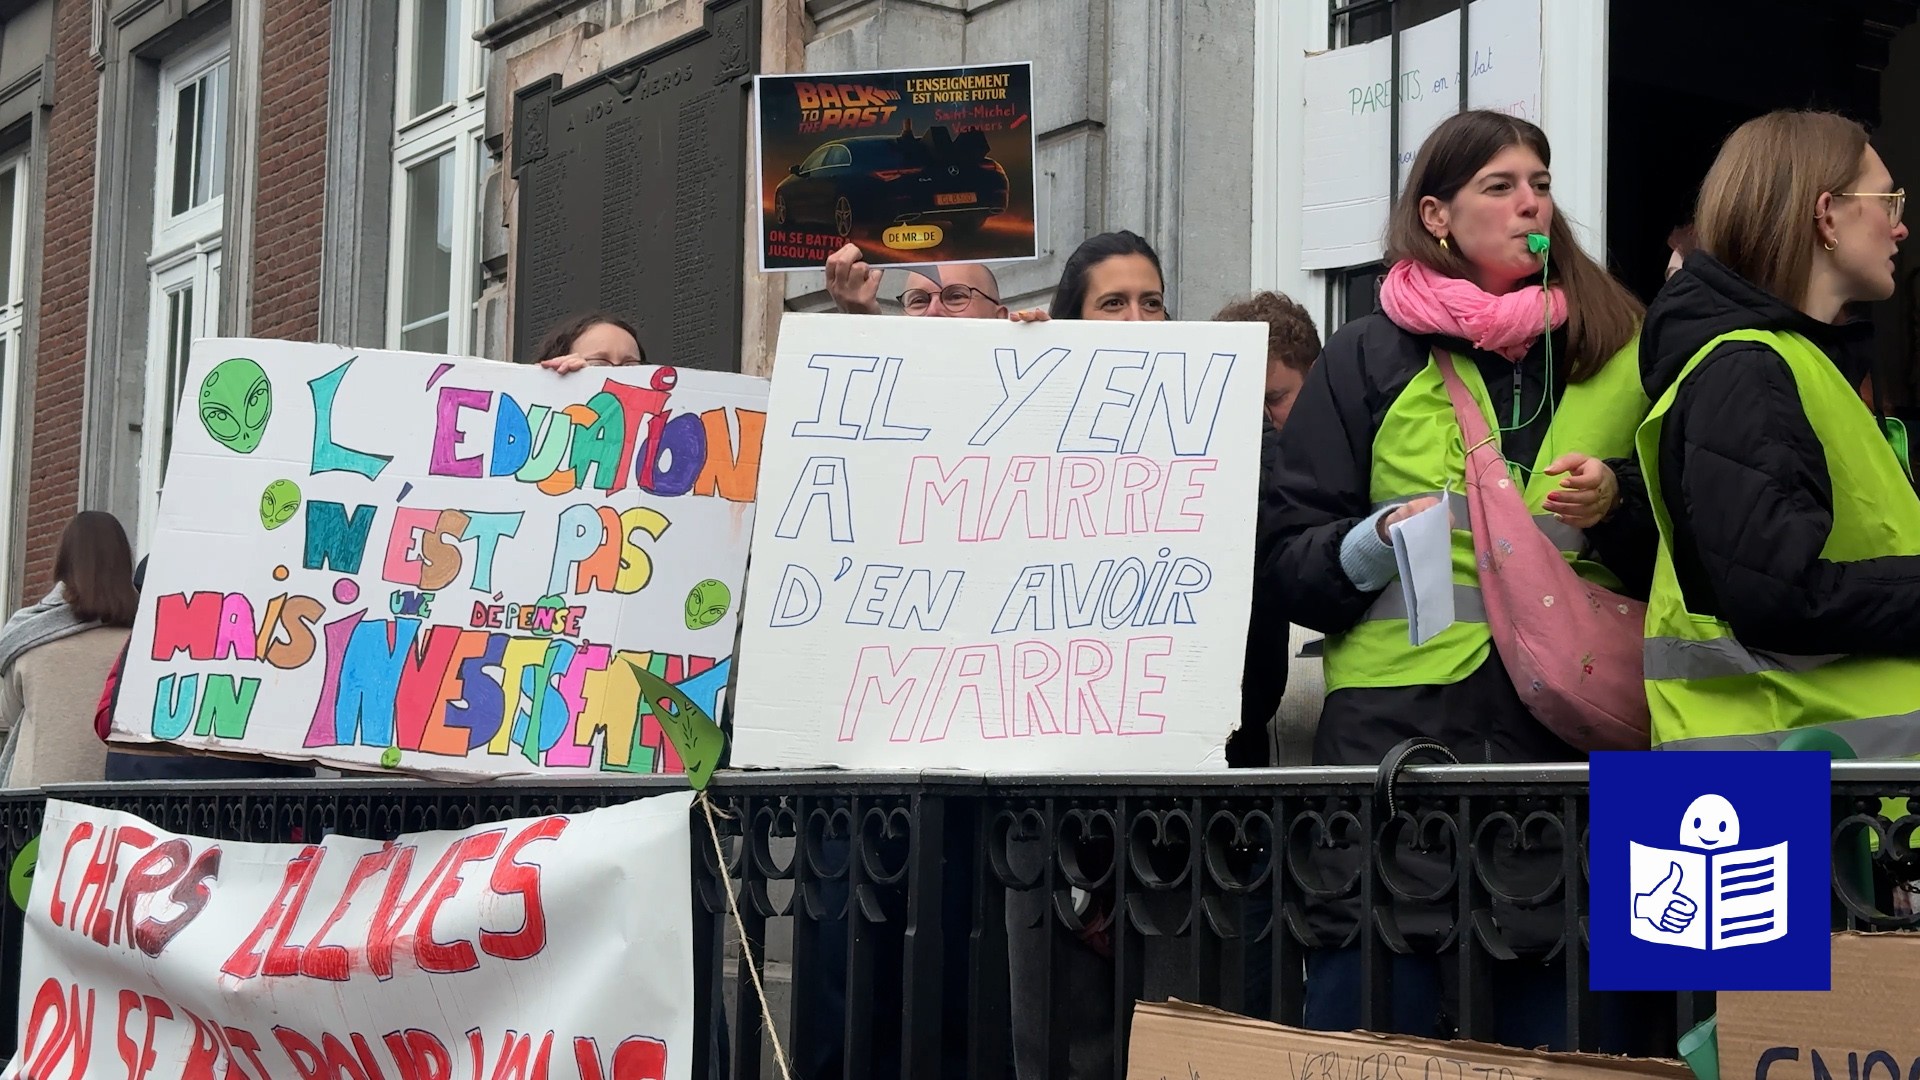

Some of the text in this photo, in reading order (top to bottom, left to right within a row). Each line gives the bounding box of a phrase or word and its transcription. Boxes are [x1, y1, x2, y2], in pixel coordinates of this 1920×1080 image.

[906, 73, 1010, 92] L'ENSEIGNEMENT
[1432, 77, 1448, 93] on
[1471, 46, 1493, 78] bat
[794, 82, 894, 109] BACK
[912, 88, 1006, 104] EST NOTRE FUTUR
[801, 109, 820, 122] TO
[820, 106, 897, 131] PAST
[769, 230, 786, 242] ON
[789, 232, 803, 244] SE
[888, 233, 900, 242] DE
[768, 245, 825, 260] JUSQU'AU
[792, 348, 1236, 456] IL Y EN
[775, 456, 1218, 544] A MARRE
[549, 503, 673, 595] PAS
[390, 589, 435, 618] UNE
[770, 557, 964, 631] D'EN
[838, 636, 1173, 742] MARRE
[151, 673, 260, 740] UN
[50, 822, 223, 958] CHERS
